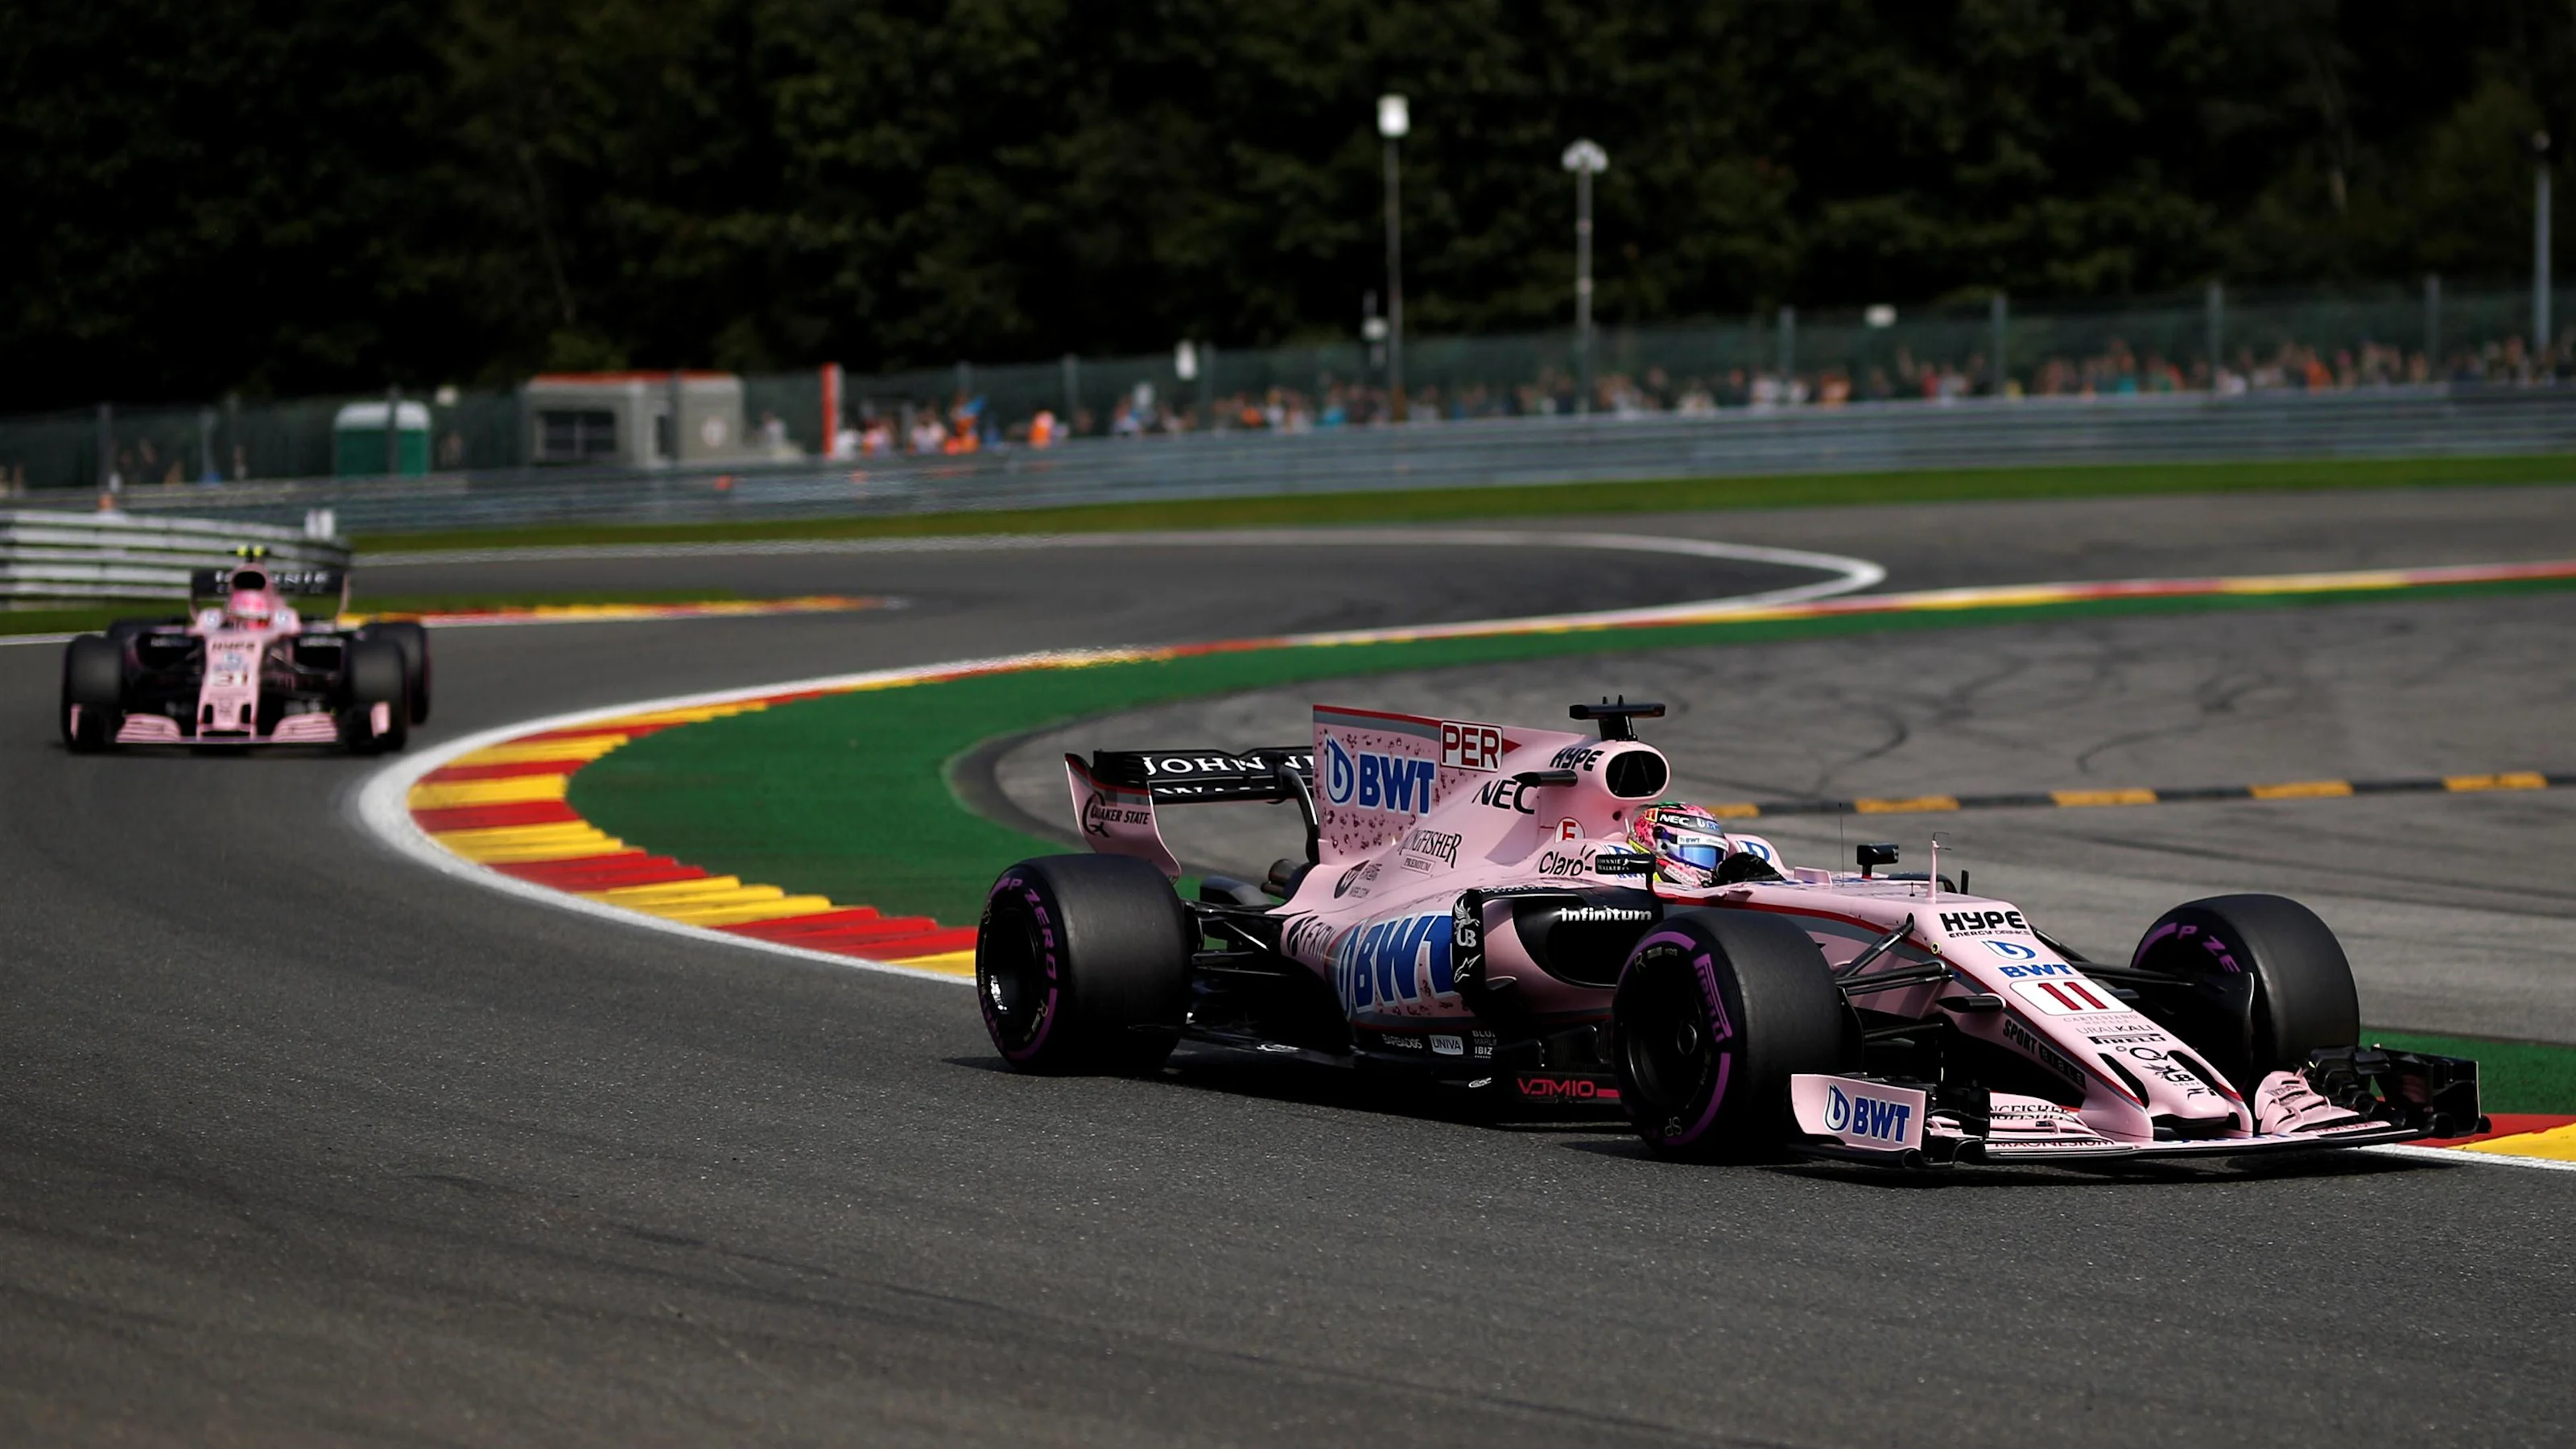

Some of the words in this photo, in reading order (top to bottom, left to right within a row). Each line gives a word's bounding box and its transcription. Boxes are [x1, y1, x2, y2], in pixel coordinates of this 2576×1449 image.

[1442, 726, 1500, 768] PER
[1550, 748, 1604, 771] HYPE
[1359, 753, 1435, 815] BWT
[1472, 779, 1537, 815] NEC
[1124, 810, 1151, 825] STATE
[1659, 814, 1690, 826] NEC
[1539, 851, 1583, 877] Claro
[1560, 906, 1652, 922] infinitum
[1939, 911, 2027, 931] HYPE
[1024, 889, 1057, 980] ZERO
[1949, 930, 1992, 938] ENERGY
[1354, 914, 1452, 1008] BWT
[2202, 935, 2242, 972] ZE
[1998, 964, 2074, 978] BWT
[2038, 982, 2109, 1010] 11
[2002, 1018, 2037, 1055] SPORT
[2076, 1025, 2154, 1034] URALKALI
[2087, 1034, 2166, 1044] PIRELLI
[1433, 1038, 1462, 1051] UNIVA
[1475, 1046, 1493, 1055] IBIZ
[1853, 1097, 1910, 1142] BWT
